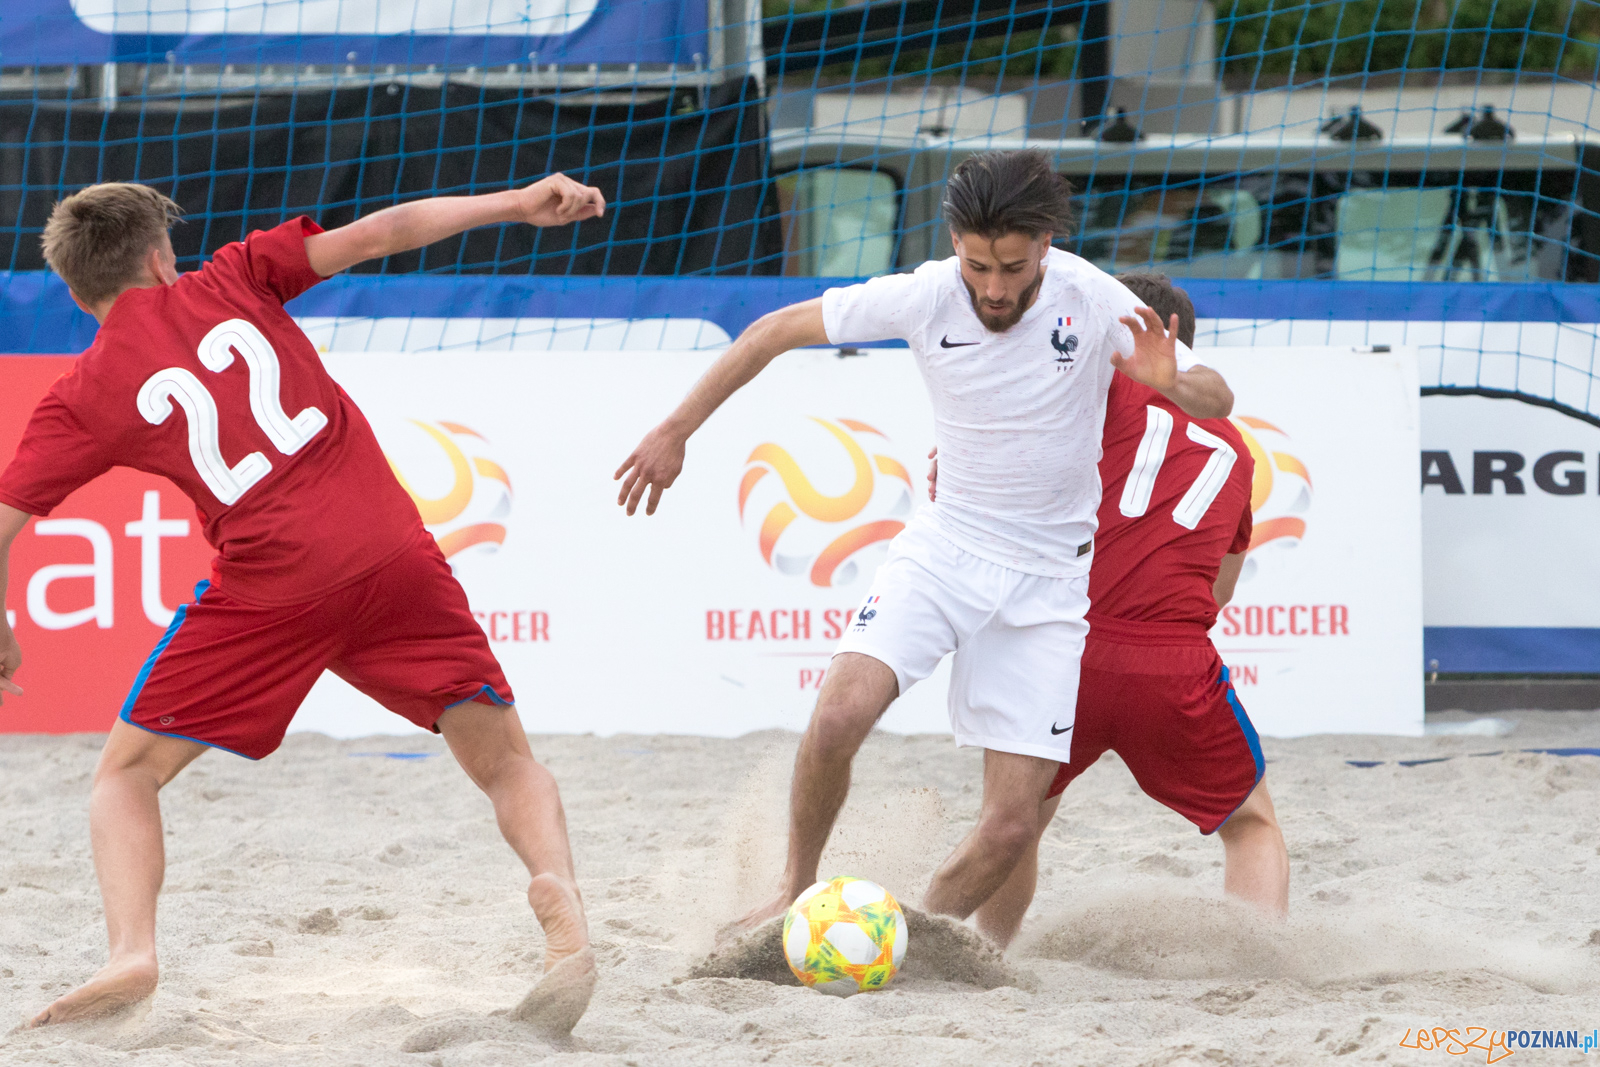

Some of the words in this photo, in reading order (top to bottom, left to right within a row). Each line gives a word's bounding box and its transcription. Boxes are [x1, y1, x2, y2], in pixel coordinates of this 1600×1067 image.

[137, 319, 328, 505] 22
[1118, 405, 1238, 530] 17
[1420, 450, 1600, 496] ARG
[6, 490, 190, 630] at
[706, 609, 811, 640] BEACH
[1222, 604, 1349, 636] SOCCER
